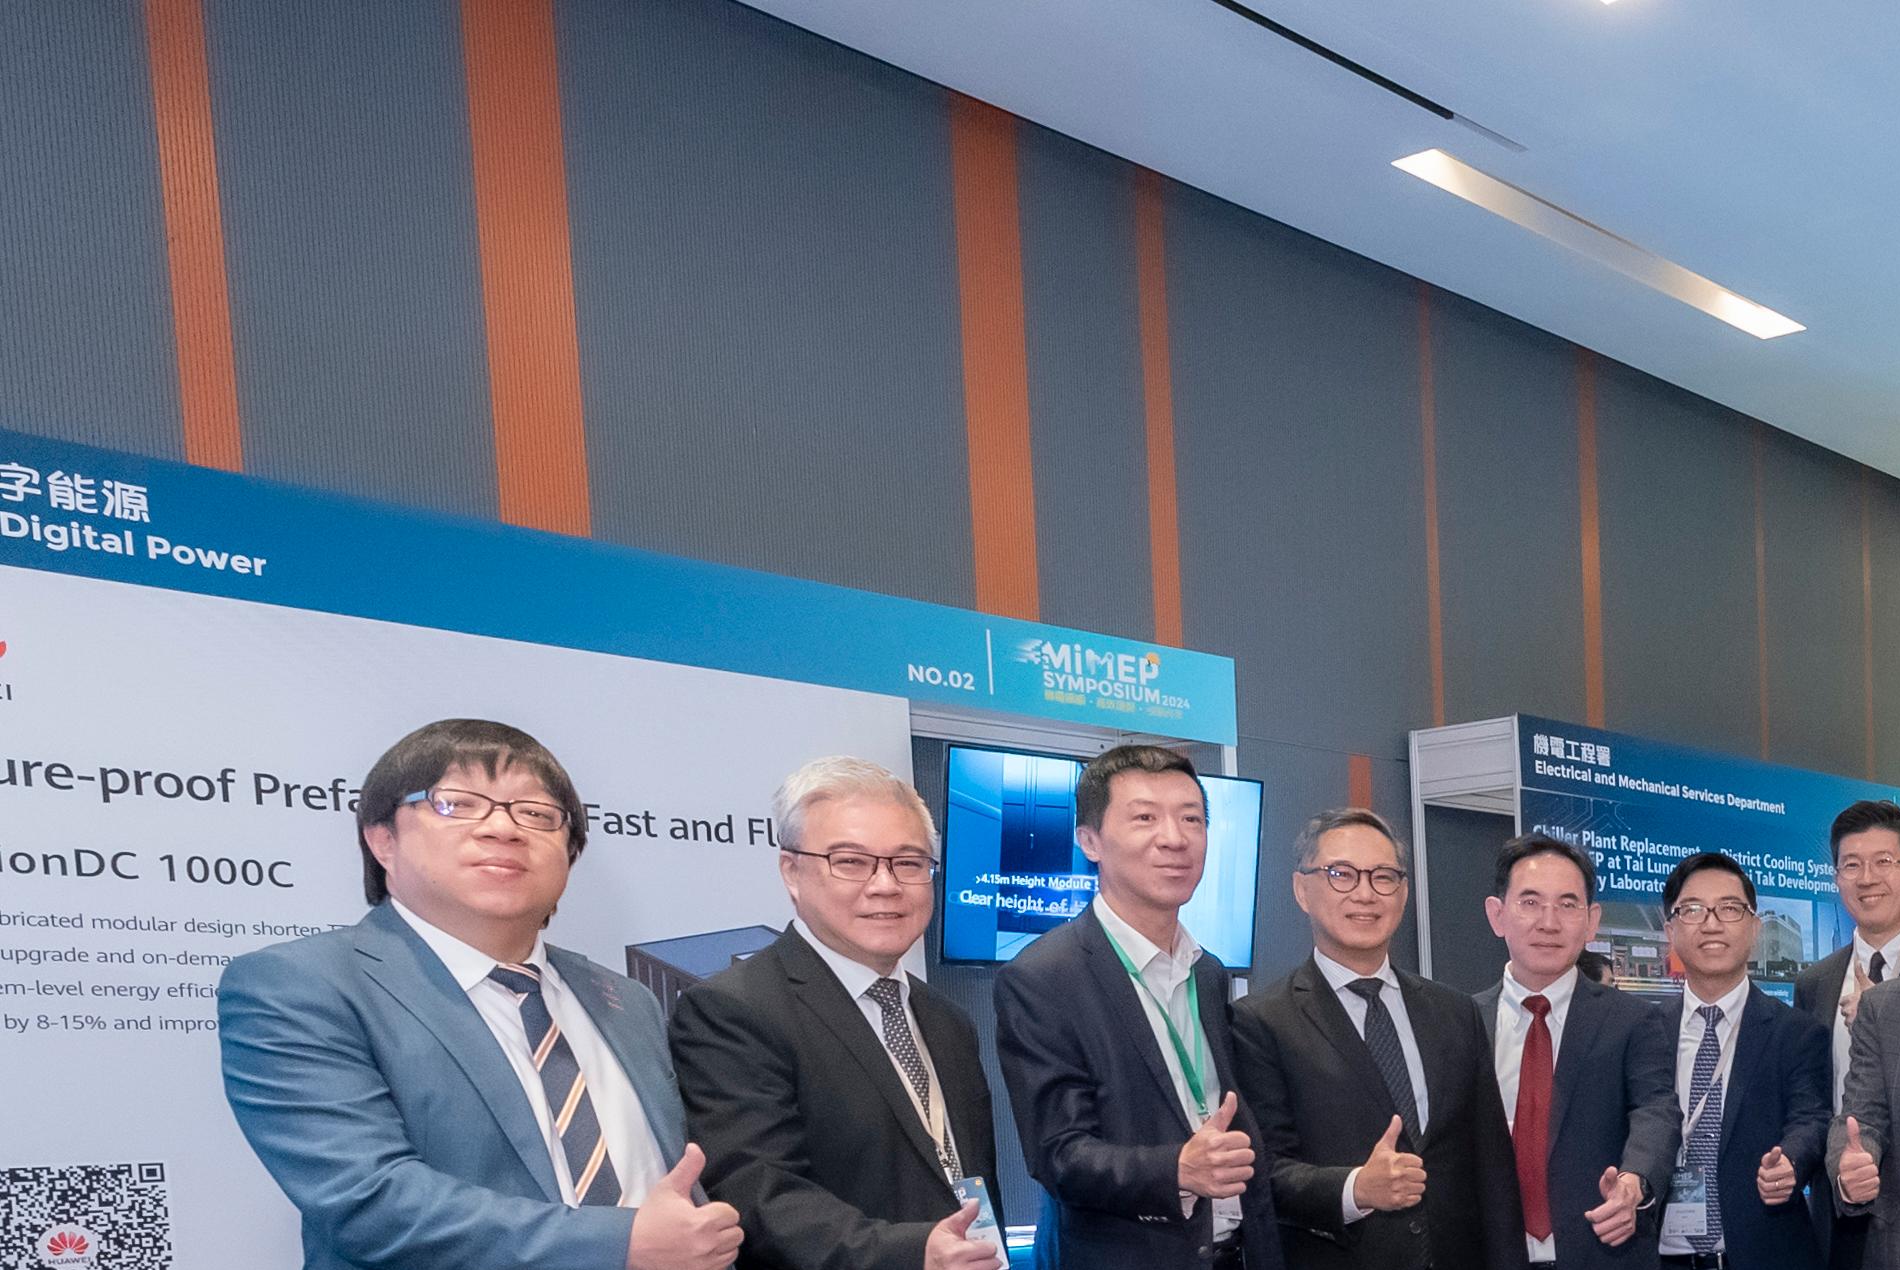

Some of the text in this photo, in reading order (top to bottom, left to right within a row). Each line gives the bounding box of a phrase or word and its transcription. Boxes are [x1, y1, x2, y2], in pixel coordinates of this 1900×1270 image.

[0, 462, 150, 522] 字能源
[0, 511, 267, 576] Digital Power
[907, 663, 975, 691] NO.02
[1043, 671, 1161, 705] SYMPOSIUM
[1161, 694, 1190, 710] 2024
[1533, 733, 1611, 768] 機電工程署
[1535, 760, 1786, 815] Electrical and Mechanical Services Department
[582, 803, 658, 838] Fast
[669, 814, 734, 844] and
[748, 817, 780, 848] Fl
[1582, 830, 1617, 851] Plant
[160, 854, 294, 888] 1000C
[1607, 857, 1621, 869] at
[1624, 855, 1644, 872] Tai
[1763, 853, 1805, 876] Cooling
[1808, 859, 1838, 877] Syste
[1012, 875, 1045, 889] Height
[1048, 877, 1092, 890] Module
[1755, 871, 1775, 887] Tak
[959, 889, 993, 906] Clear
[996, 893, 1044, 914] height
[92, 916, 178, 932] modular
[184, 918, 246, 938] design
[1, 947, 235, 967] upgrade and on-dema
[91, 984, 160, 1001] energy
[4, 1013, 219, 1034] by 8-15% and impro
